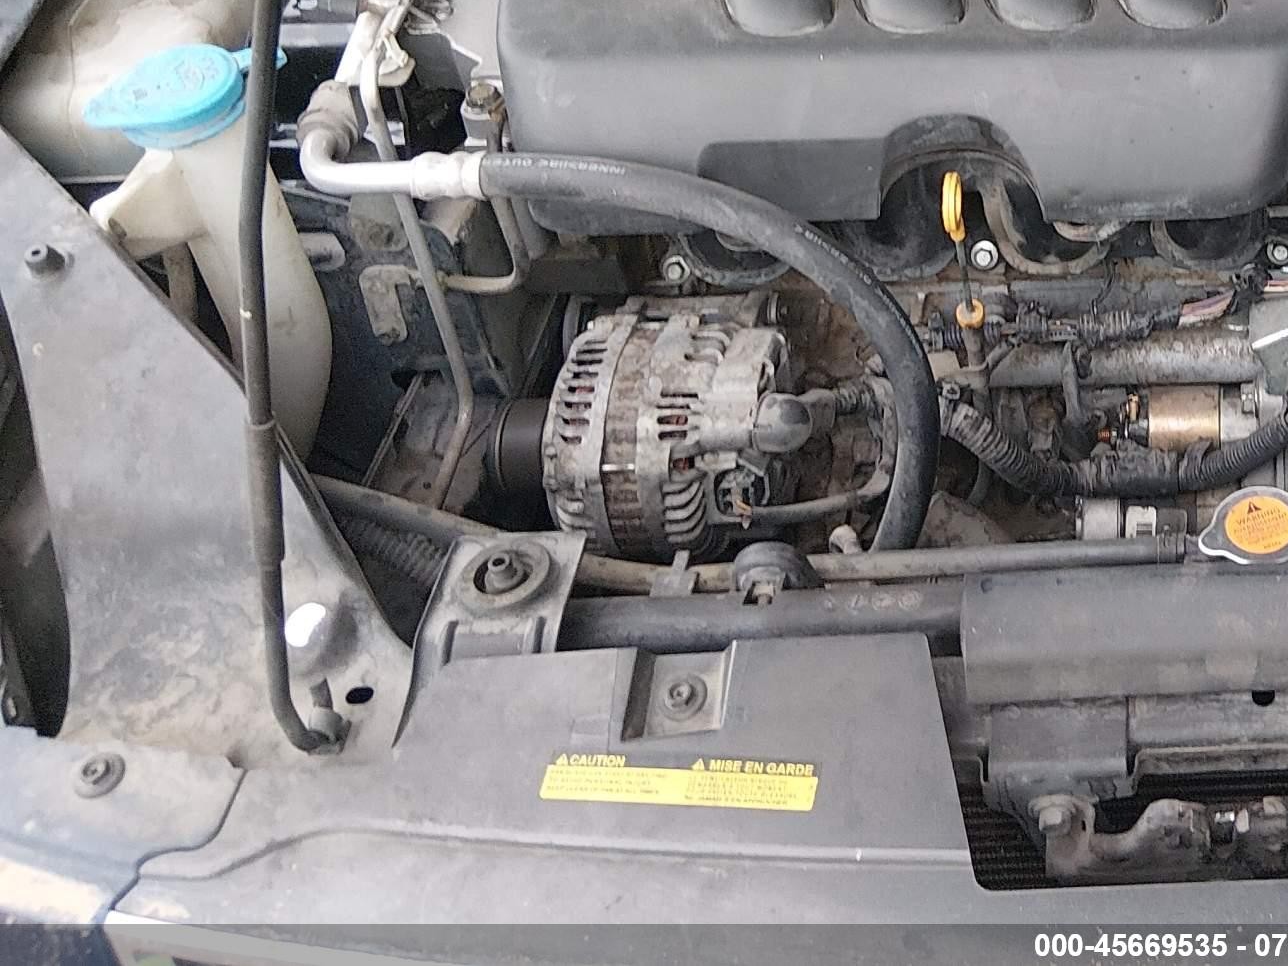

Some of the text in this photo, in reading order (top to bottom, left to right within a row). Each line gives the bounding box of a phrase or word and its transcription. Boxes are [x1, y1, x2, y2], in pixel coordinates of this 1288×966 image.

[569, 754, 625, 767] CAUTION
[708, 759, 814, 776] MISE EN GARDE
